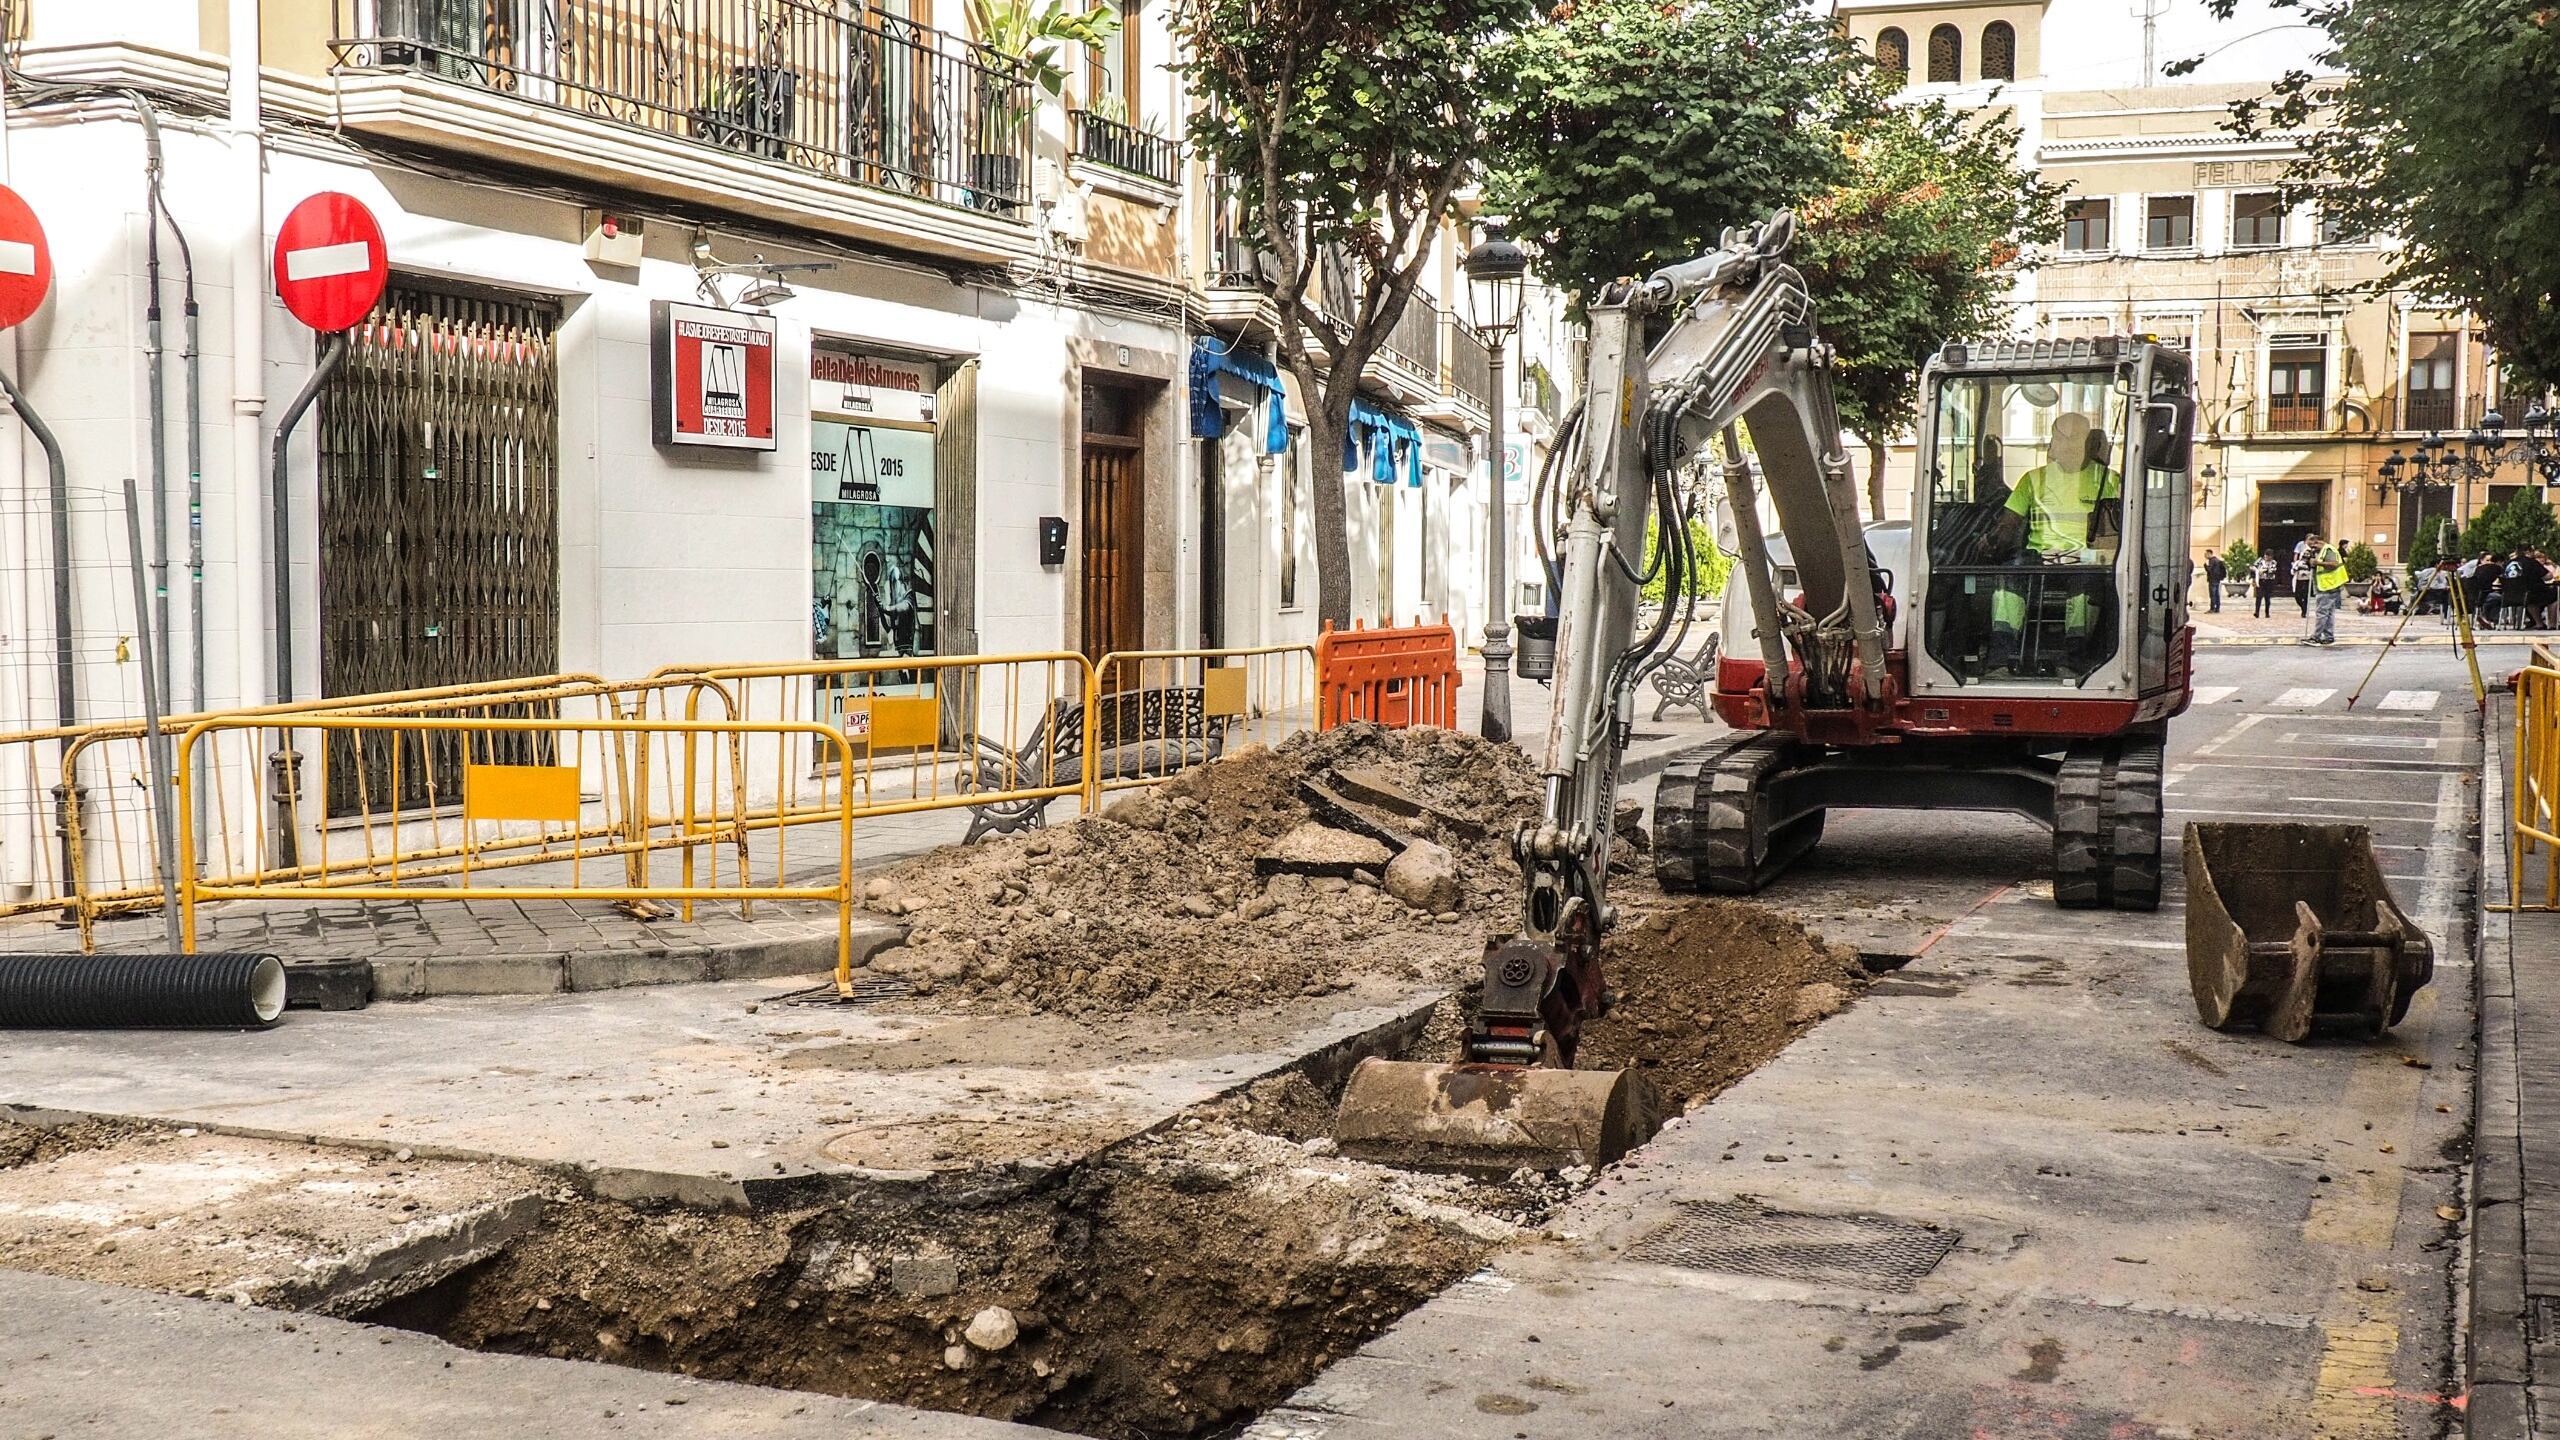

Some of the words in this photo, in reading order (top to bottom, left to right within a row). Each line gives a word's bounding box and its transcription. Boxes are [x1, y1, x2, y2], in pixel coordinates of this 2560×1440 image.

[2193, 161, 2272, 186] FELIZ
[703, 418, 728, 437] DESDE
[727, 420, 747, 437] 2015
[811, 452, 836, 472] ESDE
[880, 457, 903, 477] 2015
[841, 488, 877, 501] MILAGROSA
